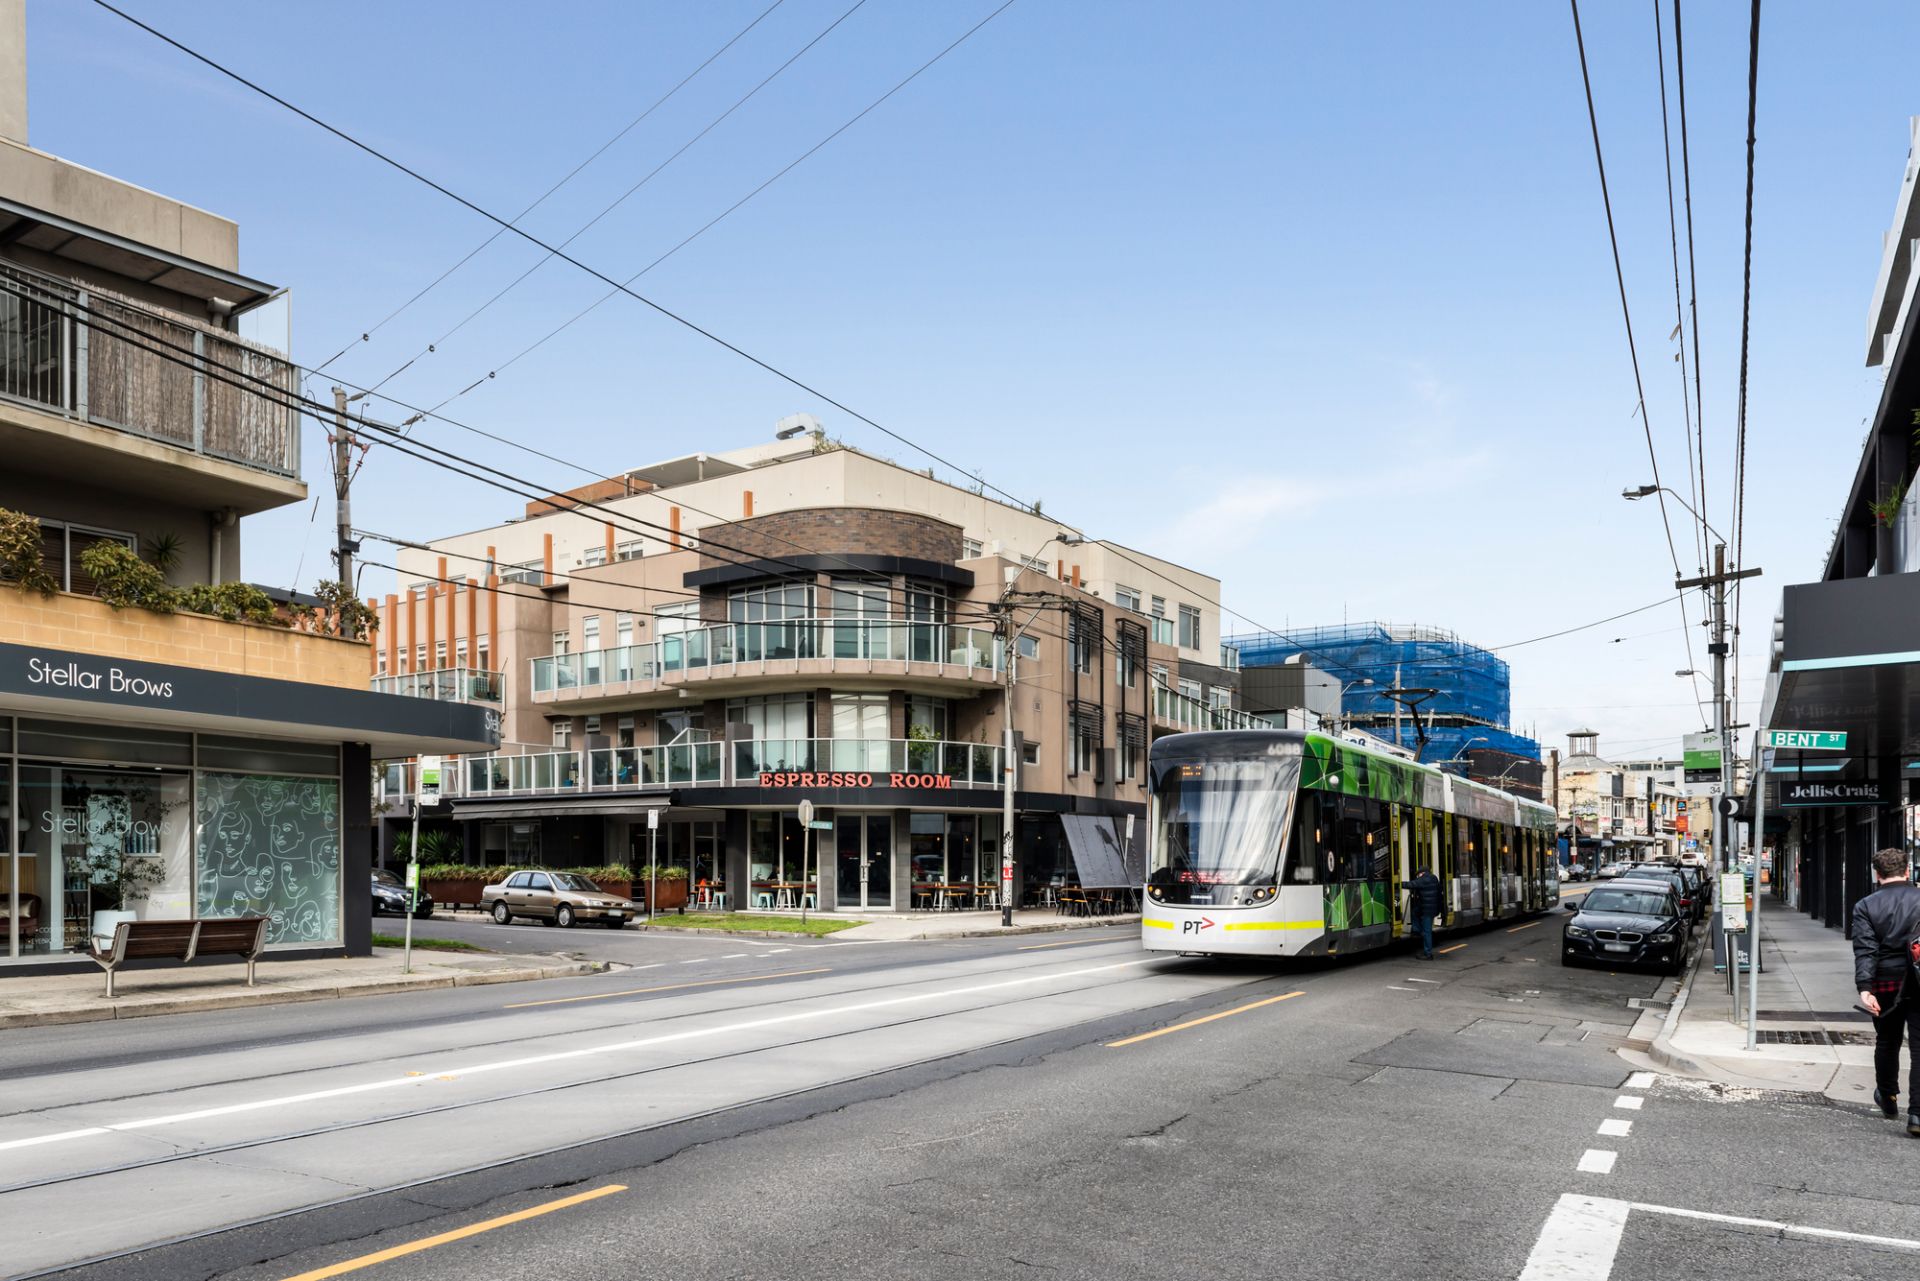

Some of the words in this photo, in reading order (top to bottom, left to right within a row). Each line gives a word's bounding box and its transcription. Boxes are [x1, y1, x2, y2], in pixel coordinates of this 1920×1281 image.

[28, 657, 102, 690] Stellar
[110, 667, 173, 698] Brows
[1775, 732, 1821, 747] BENT
[1829, 734, 1841, 742] ST
[759, 773, 873, 788] ESPRESSO
[889, 774, 952, 790] ROOM
[1710, 786, 1721, 795] 34
[40, 810, 105, 834] Stellar
[114, 812, 171, 835] Brows
